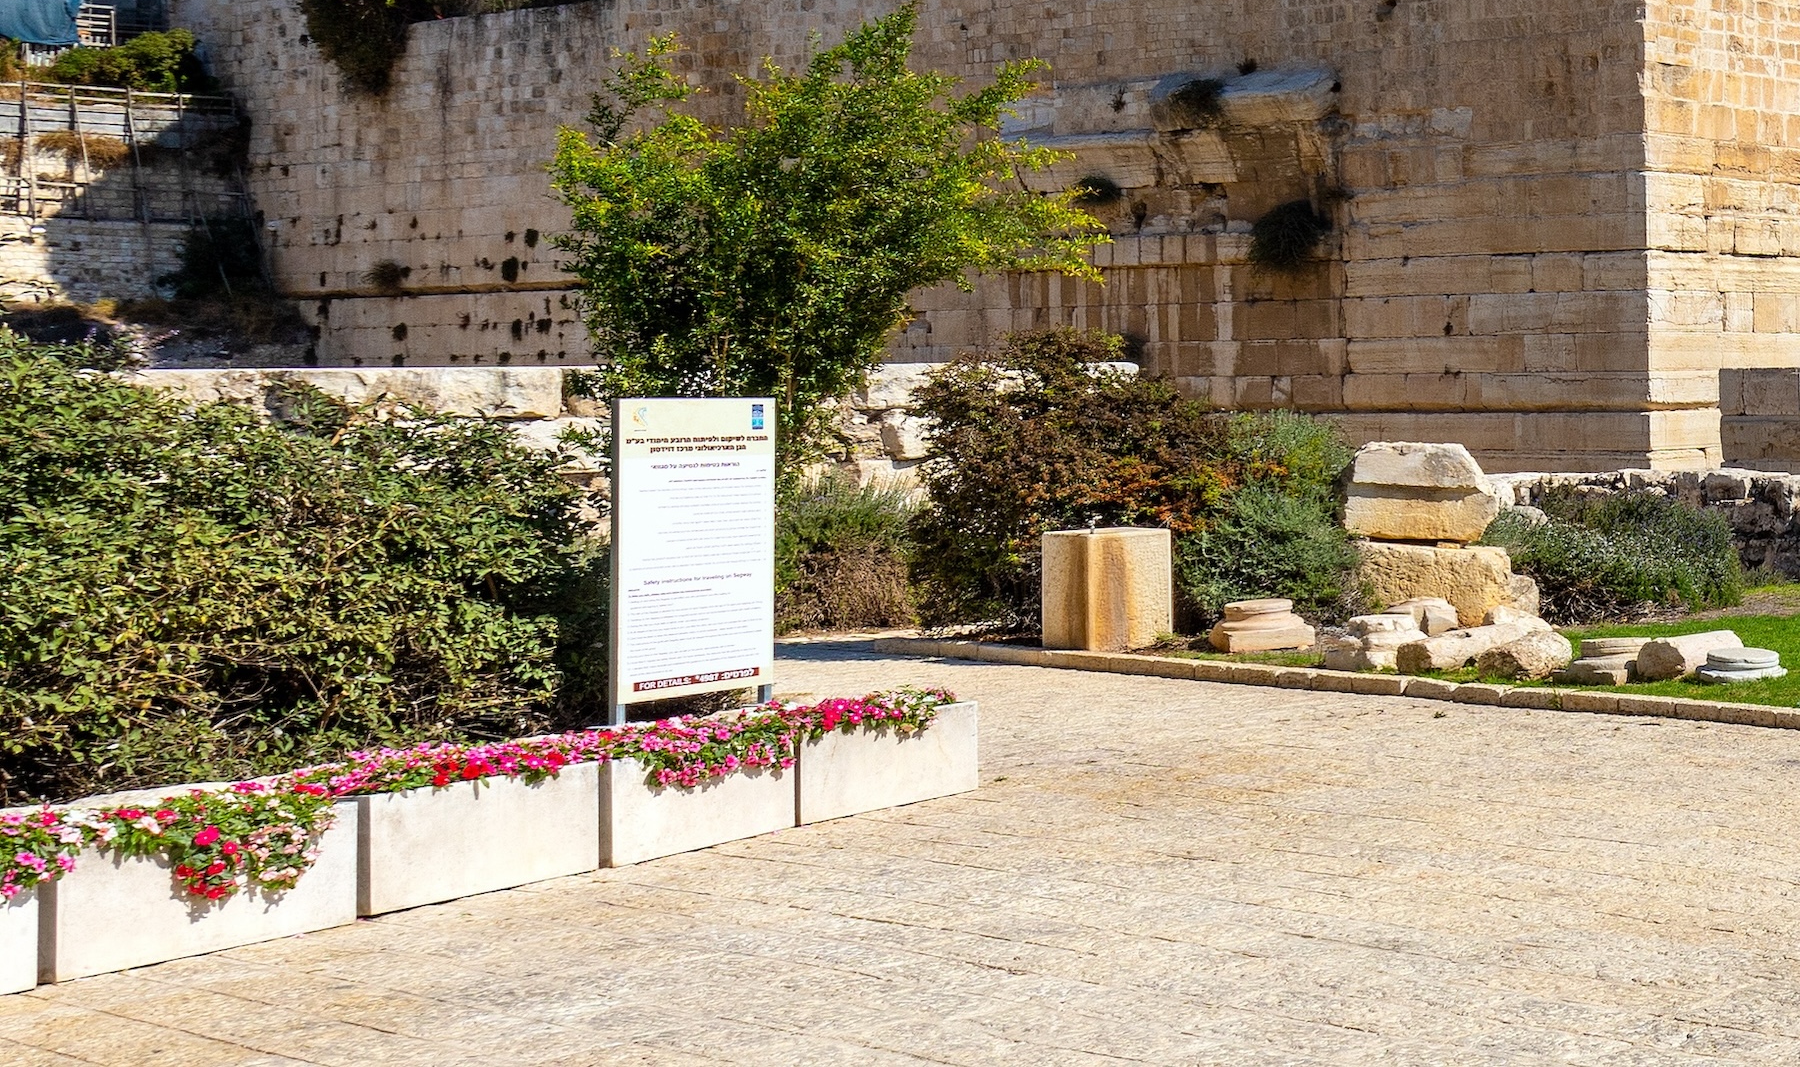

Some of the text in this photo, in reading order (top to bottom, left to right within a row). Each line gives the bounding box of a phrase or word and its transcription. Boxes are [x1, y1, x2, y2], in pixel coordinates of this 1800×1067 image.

[721, 435, 745, 443] לשיקום
[639, 682, 656, 690] FOR
[657, 678, 691, 688] DETAILS:
